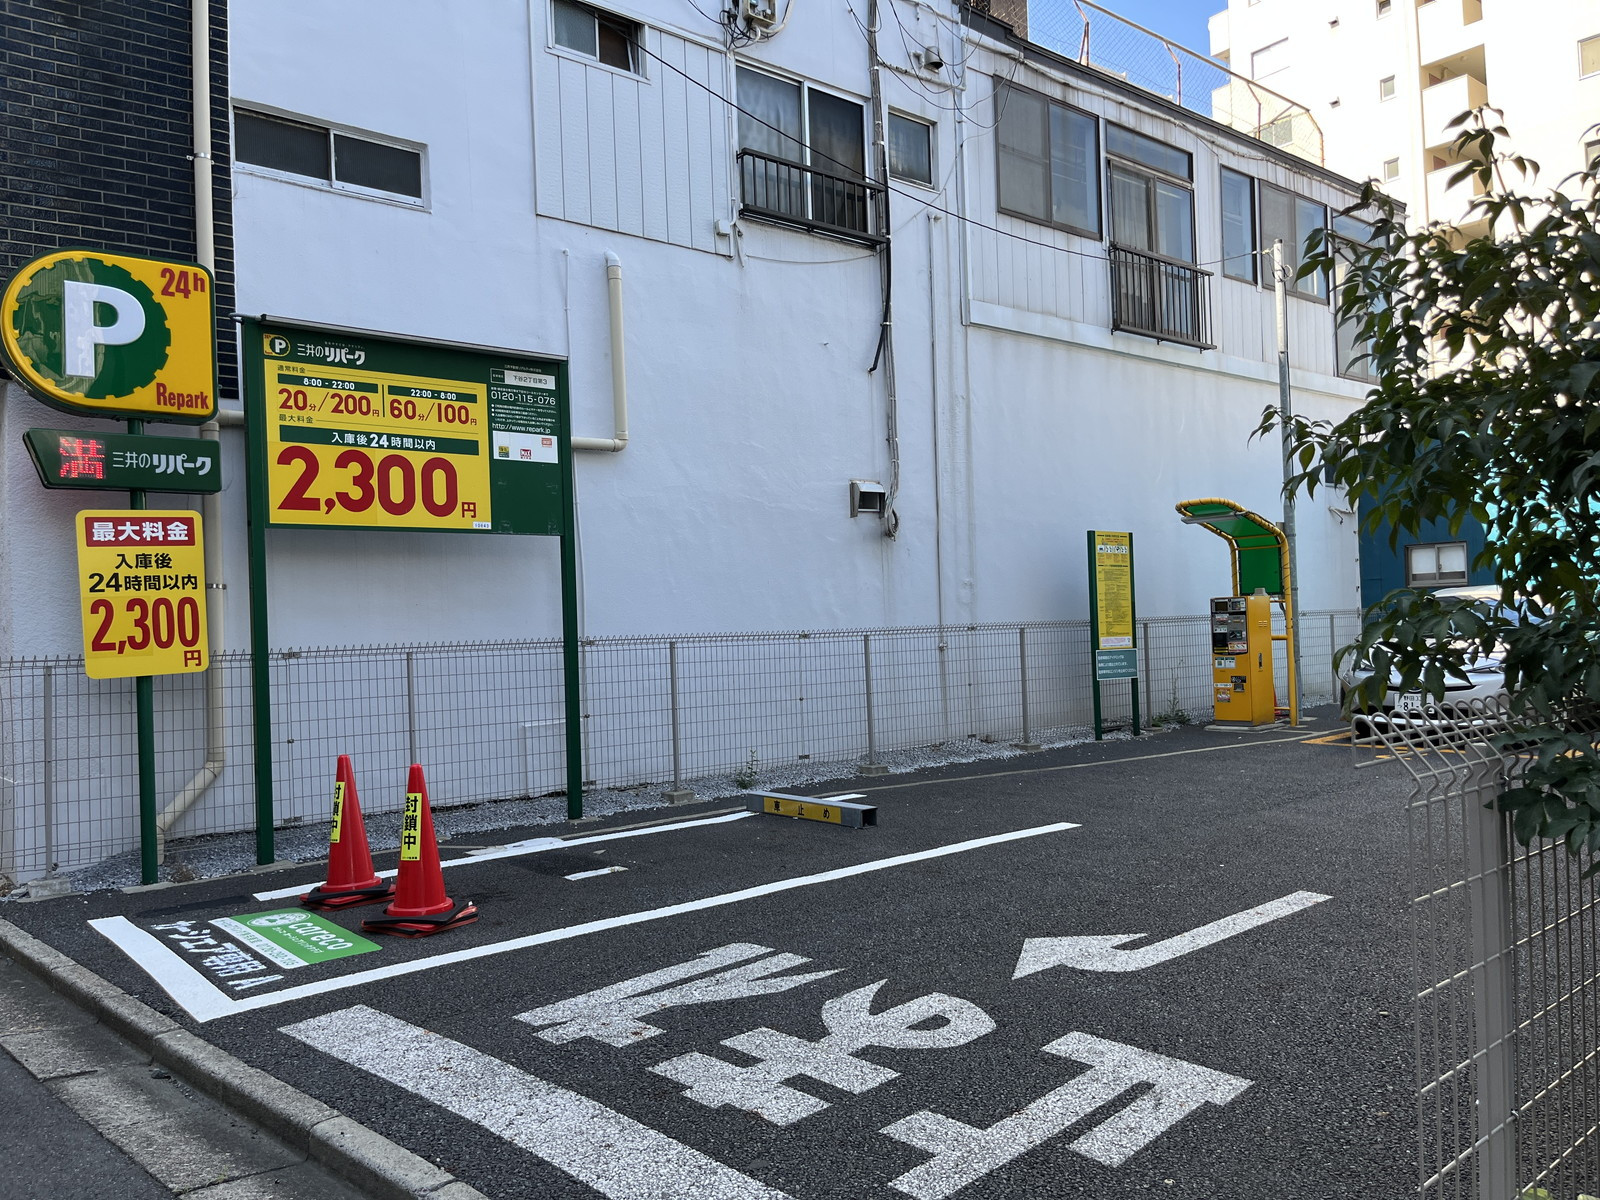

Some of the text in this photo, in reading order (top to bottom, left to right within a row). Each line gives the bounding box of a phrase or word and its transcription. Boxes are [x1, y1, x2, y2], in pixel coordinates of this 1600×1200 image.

[161, 268, 205, 299] 24h
[64, 280, 146, 378] P
[297, 342, 366, 366] 三井のリパーク
[277, 365, 306, 374] 通常料金
[303, 378, 322, 387] 8:00
[332, 381, 355, 390] 22:00
[156, 383, 209, 411] Repark
[410, 389, 432, 398] 22:00
[440, 391, 457, 401] 8:00
[490, 391, 556, 405] 0120-115-076
[278, 414, 314, 424] 最大料金
[331, 431, 437, 451] 入庫後24時間以内
[59, 436, 106, 479] 満
[112, 451, 212, 476] 三井のリパーク
[92, 521, 189, 542] 最大料金
[115, 553, 173, 570] 入庫後
[89, 572, 198, 593] 24時間以内
[773, 800, 831, 820] 車止め
[403, 795, 419, 850] 封鎖中
[288, 921, 354, 951] careco
